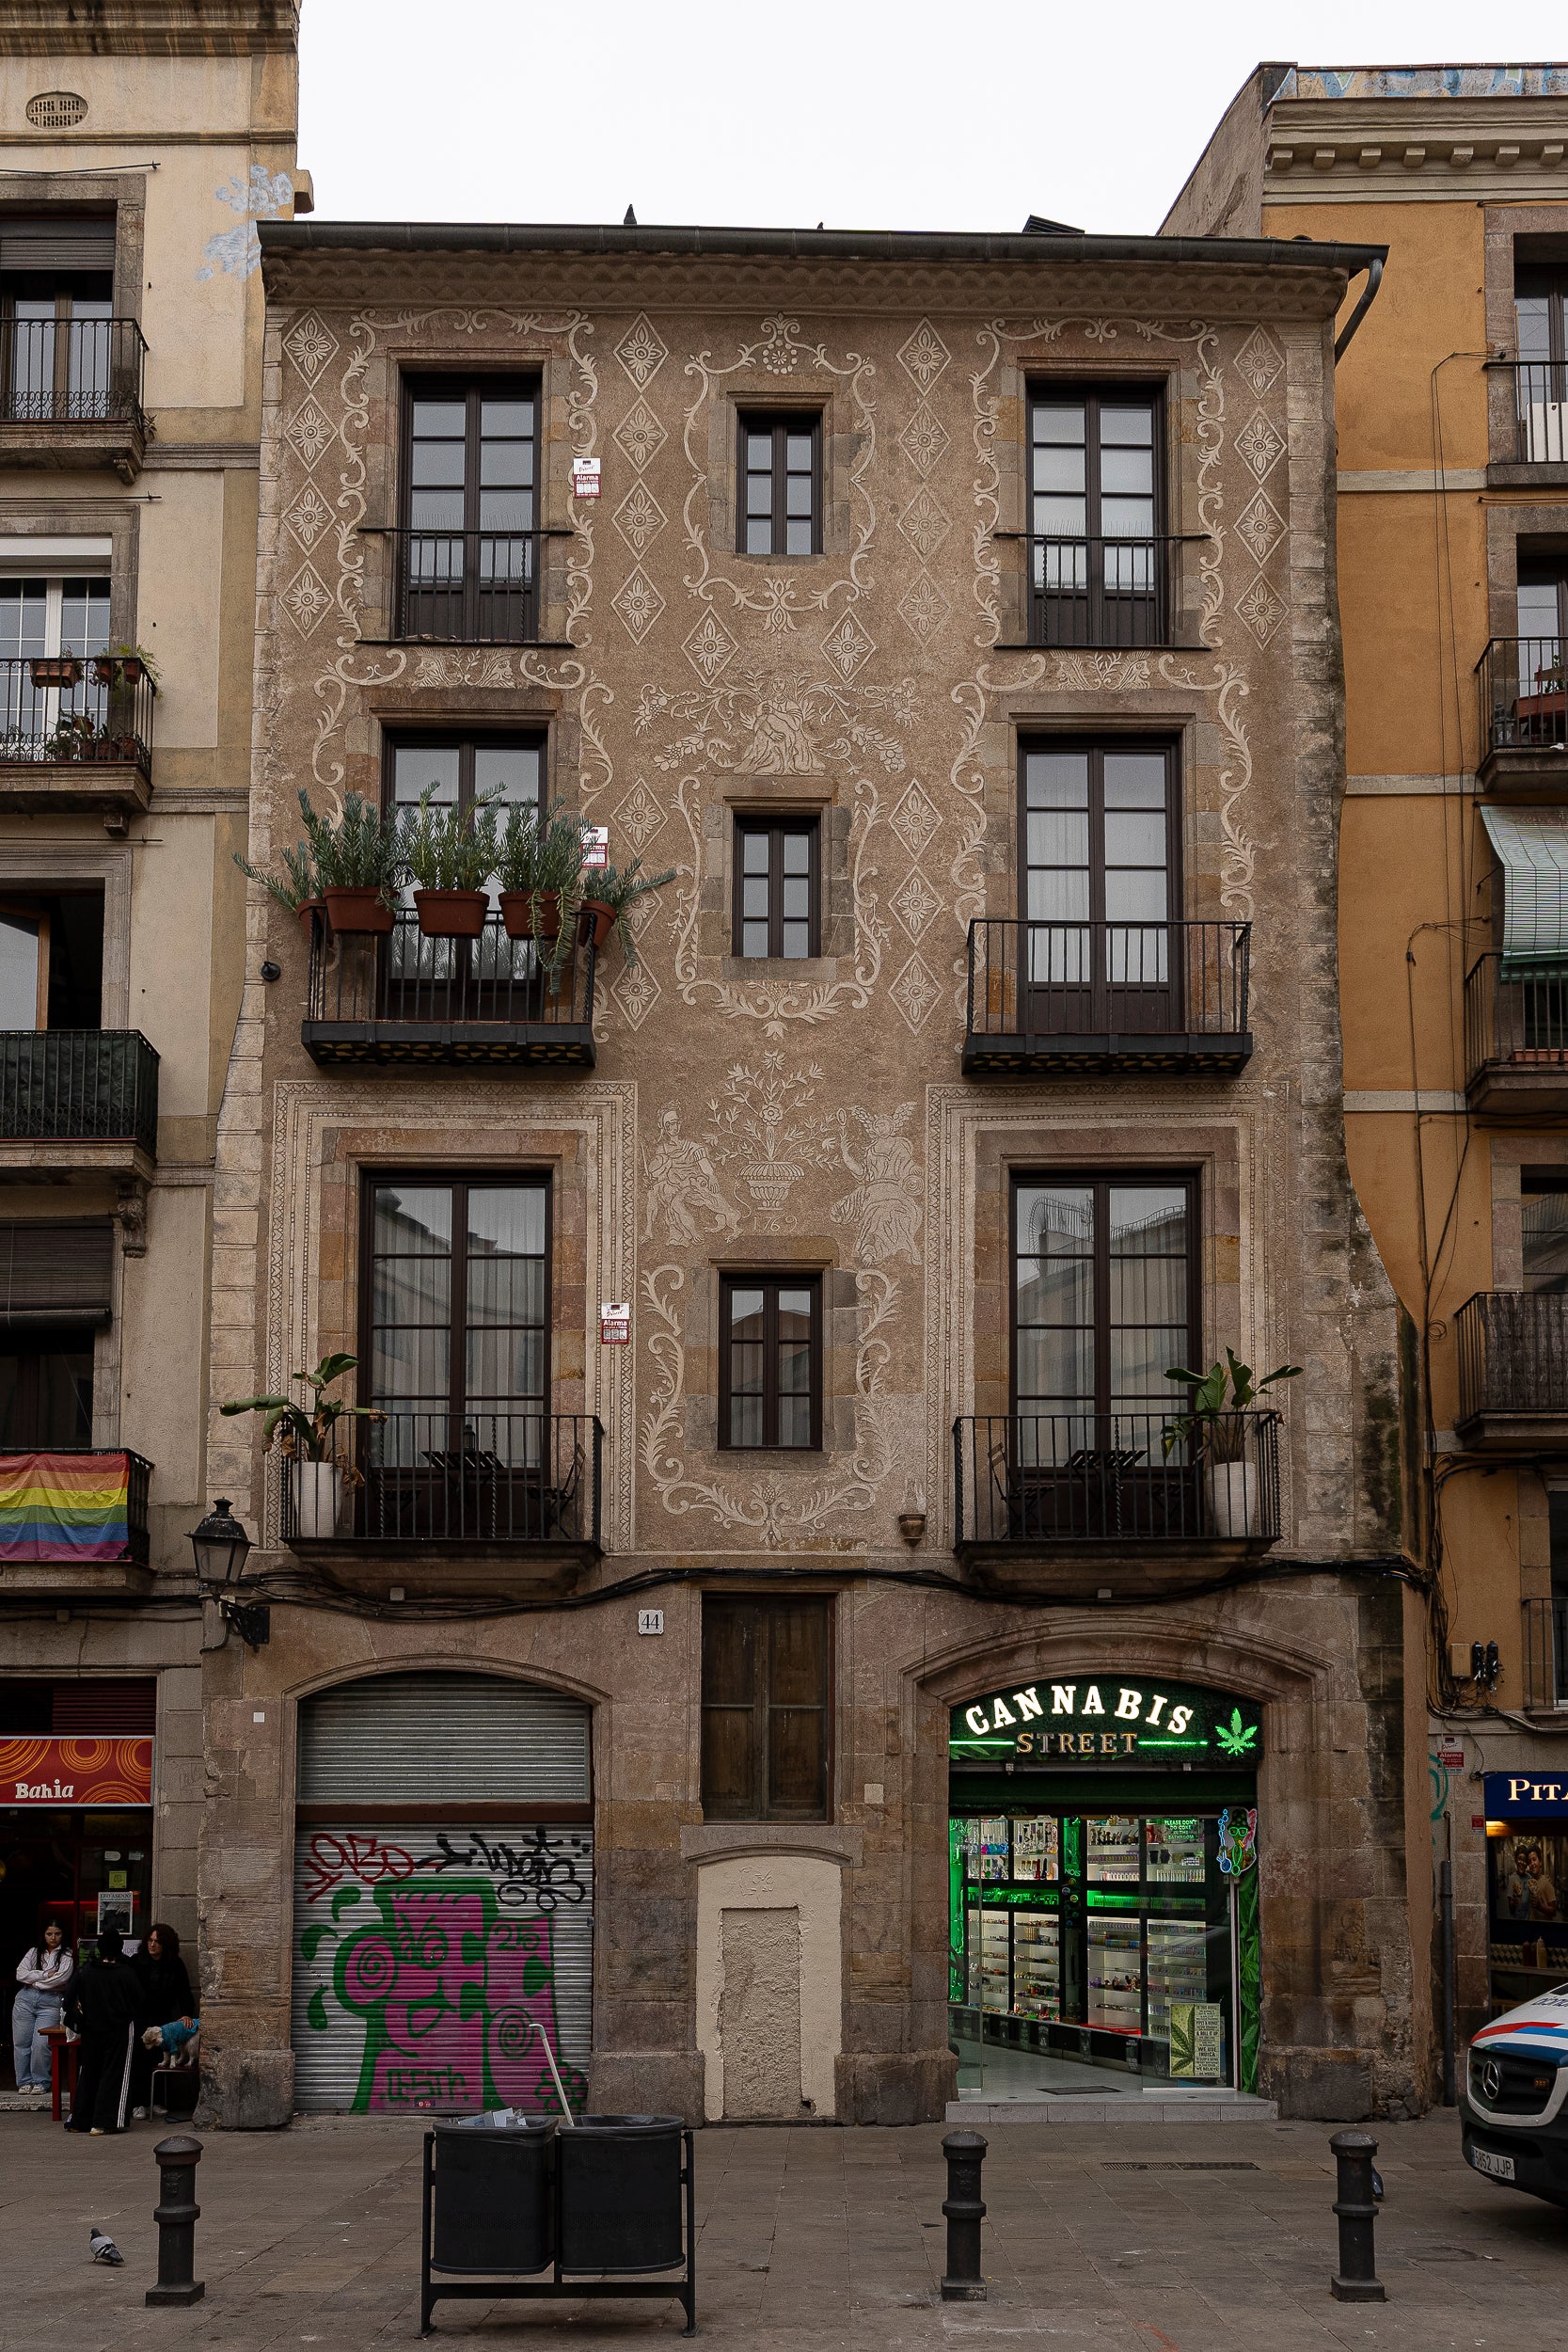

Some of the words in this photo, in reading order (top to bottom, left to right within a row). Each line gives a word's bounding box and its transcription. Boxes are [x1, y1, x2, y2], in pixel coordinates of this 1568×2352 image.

[753, 1215, 798, 1232] 1769
[641, 1613, 659, 1629] 44
[965, 1685, 1194, 1736] CANNABIS
[1016, 1732, 1138, 1754] STREET
[15, 1778, 74, 1799] Bahia
[1494, 2157, 1512, 2175] JJP
